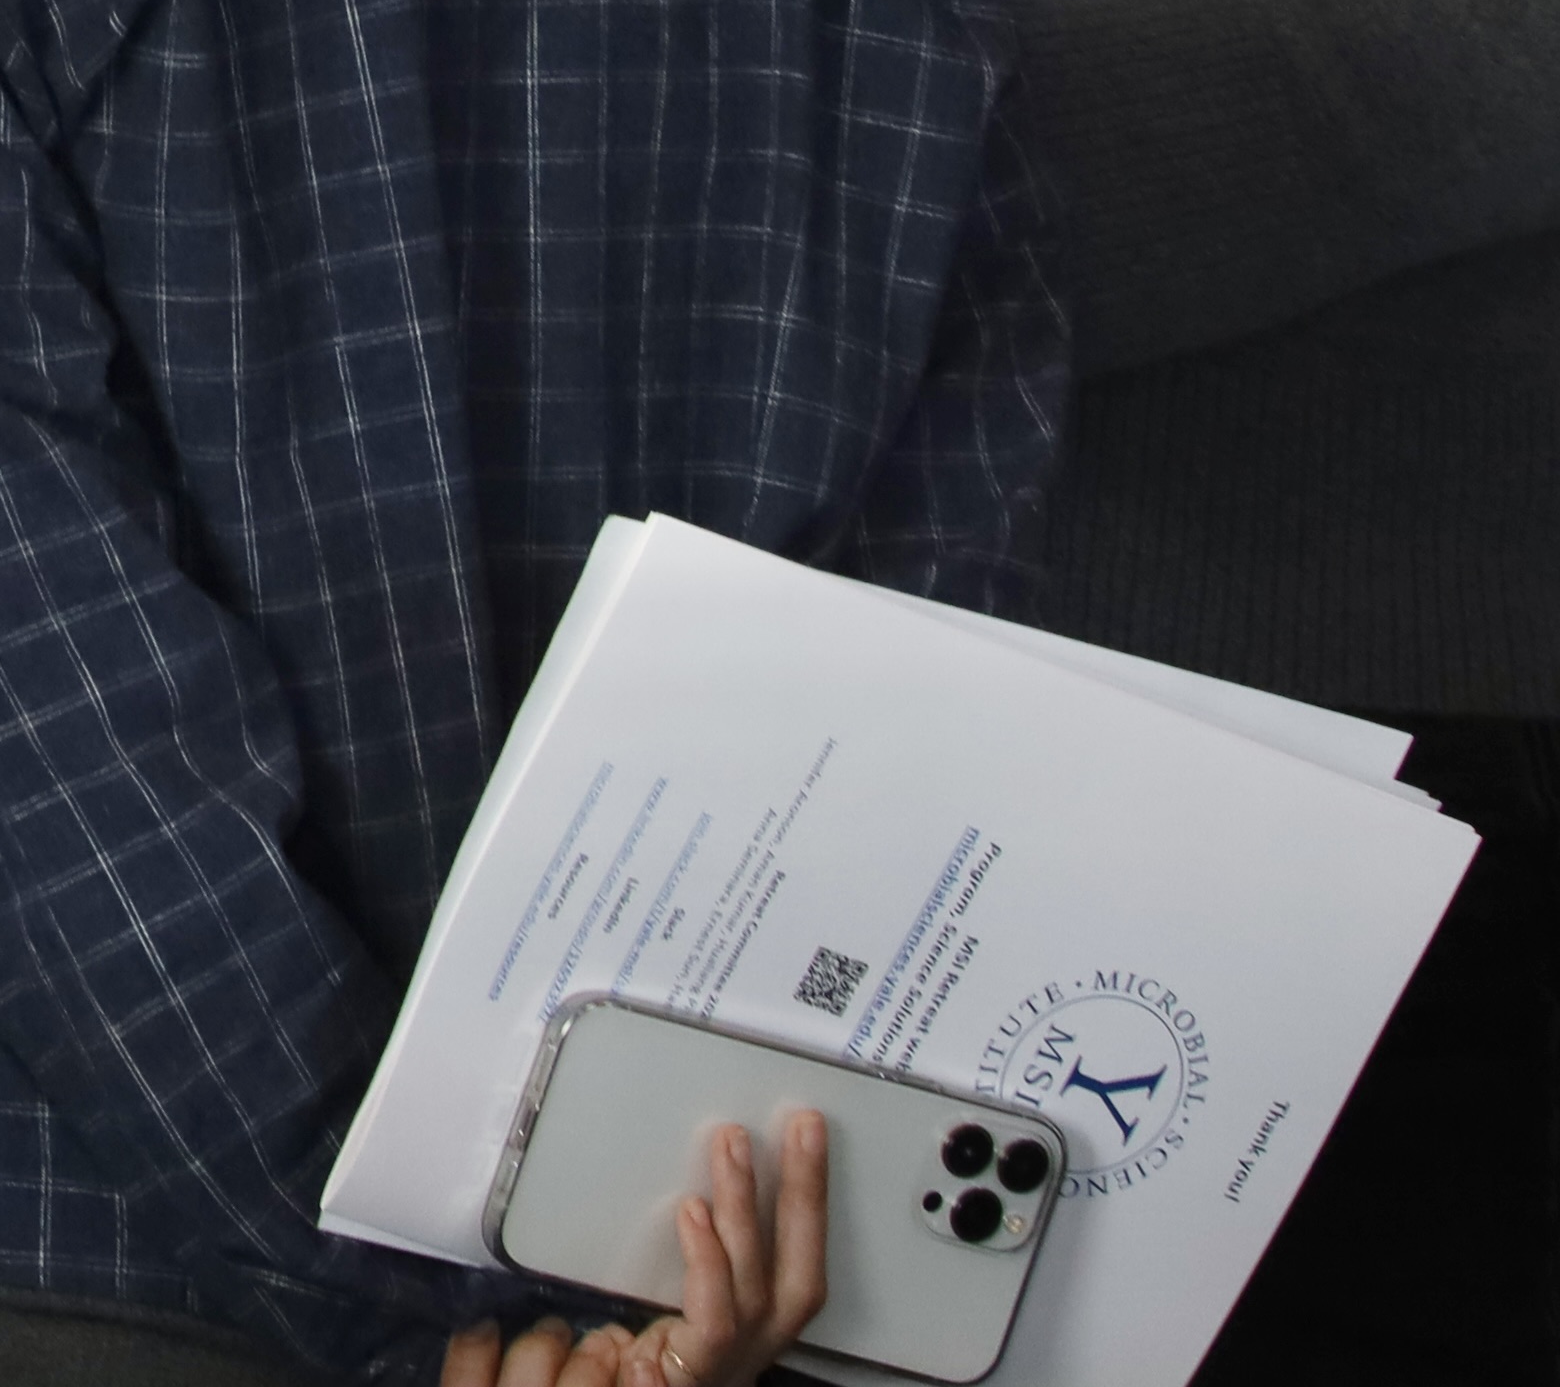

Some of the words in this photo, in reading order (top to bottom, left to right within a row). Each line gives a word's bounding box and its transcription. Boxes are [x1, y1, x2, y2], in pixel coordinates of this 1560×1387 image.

[752, 870, 786, 919] Retreat
[949, 842, 1002, 917] Program,
[661, 907, 685, 941] Slack
[916, 923, 957, 984] Science
[951, 935, 979, 970] MSI
[713, 920, 758, 993] Committee
[916, 971, 959, 1034] Retreat
[1015, 1024, 1078, 1108] MSI
[1093, 970, 1210, 1110] MICROBIAL
[1060, 1055, 1168, 1147] Y
[1248, 1101, 1290, 1156] Thank
[1224, 1158, 1254, 1203] you!
